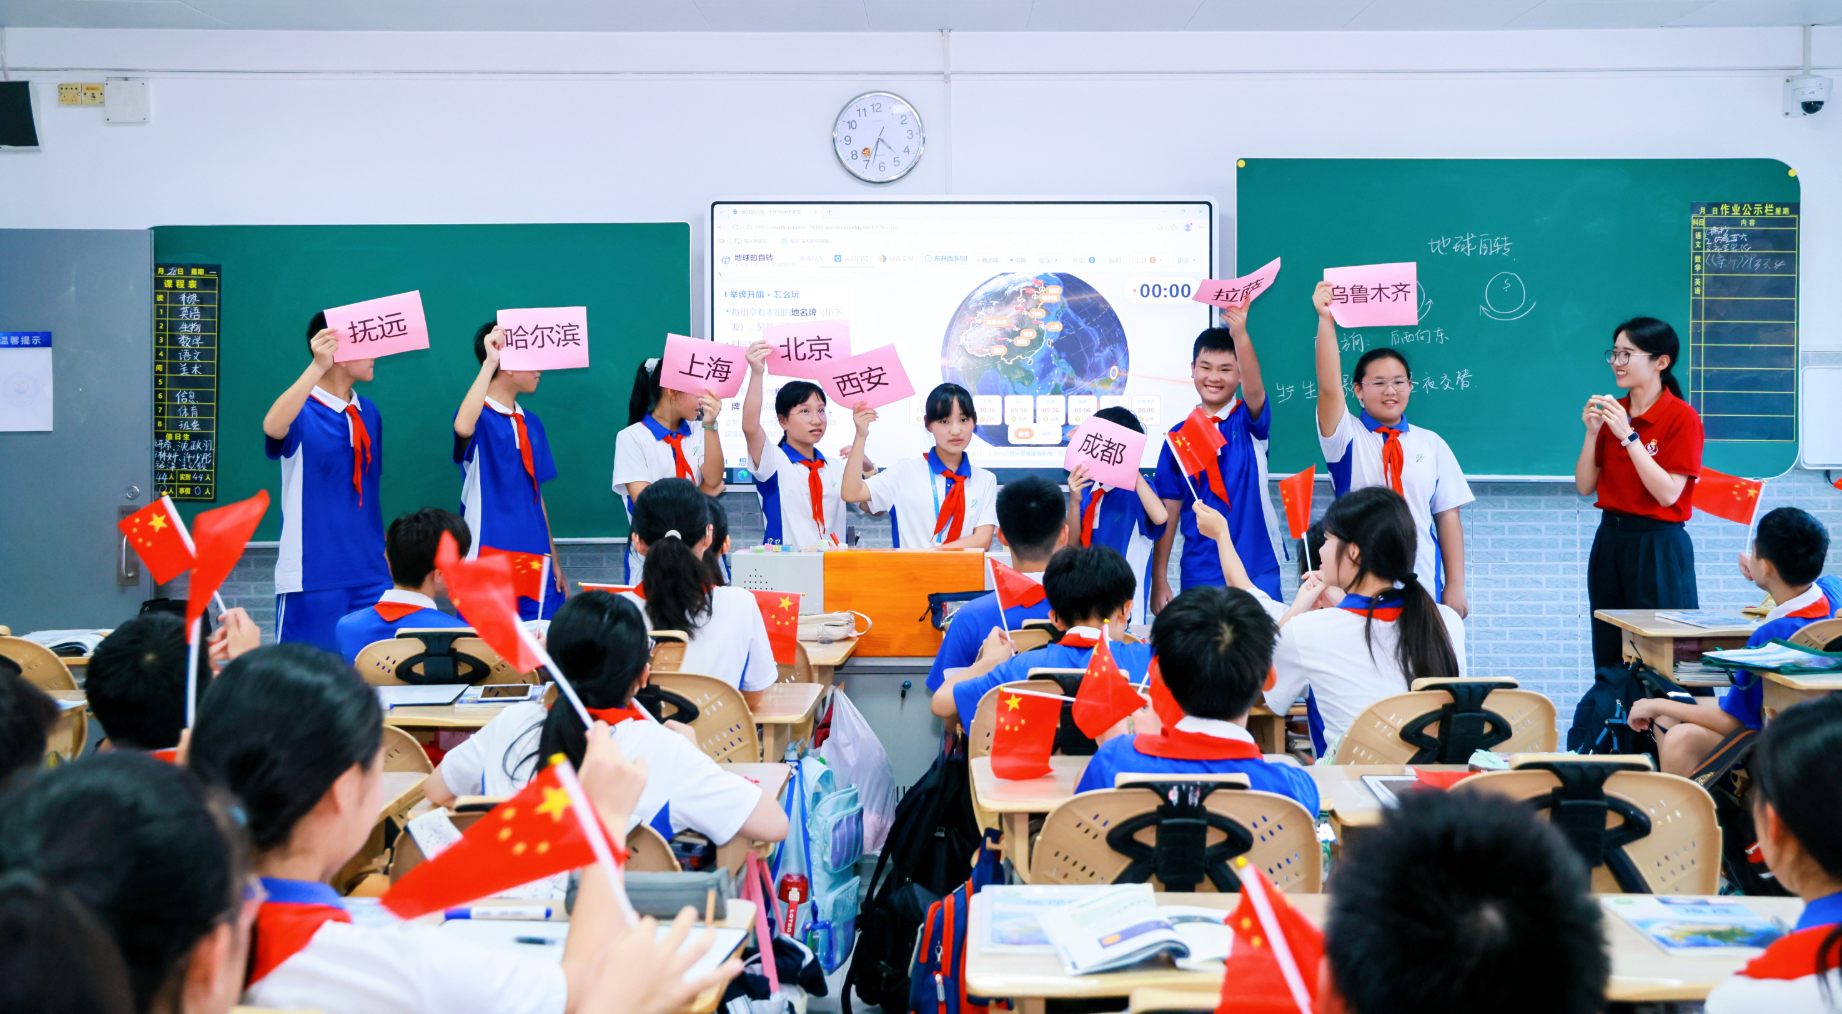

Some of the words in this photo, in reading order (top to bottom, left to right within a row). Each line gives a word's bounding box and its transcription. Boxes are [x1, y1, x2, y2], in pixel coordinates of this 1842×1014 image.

[856, 107, 867, 117] 11
[870, 102, 882, 113] 12
[846, 119, 857, 130] 10
[900, 114, 908, 125] 2
[844, 135, 852, 146] 9
[906, 129, 914, 139] 3
[850, 149, 858, 160] 8
[903, 145, 911, 155] 4
[863, 159, 870, 169] 7
[878, 161, 886, 172] 6
[893, 156, 900, 167] 5
[1699, 207, 1706, 215] 月
[1712, 207, 1718, 215] 日
[1720, 203, 1774, 216] 作业公示栏
[1740, 219, 1756, 227] 内容
[1694, 231, 1702, 249] 语文
[734, 253, 774, 262] 地球的自转
[1694, 255, 1702, 272] 数学
[164, 279, 197, 289] 课程表
[1211, 277, 1264, 302] 拉萨
[1694, 278, 1701, 294] 英语
[729, 290, 765, 299] 举牌升旗
[773, 290, 800, 299] 怎么玩
[1139, 283, 1192, 299] 00:00
[1331, 281, 1411, 304] 乌鲁木齐
[179, 306, 201, 320] 英语
[179, 322, 201, 333] 生物
[347, 311, 408, 344] 抚远
[0, 335, 41, 345] 温馨提示
[178, 334, 204, 348] 数学
[504, 322, 581, 350] 哈尔滨
[779, 335, 833, 362] 北京
[178, 349, 202, 362] 语文
[179, 363, 202, 376] 美术
[678, 352, 733, 383] 上海
[832, 365, 889, 398] 西安
[175, 389, 199, 405] 信息
[177, 404, 198, 418] 体育
[1077, 432, 1127, 467] 成都
